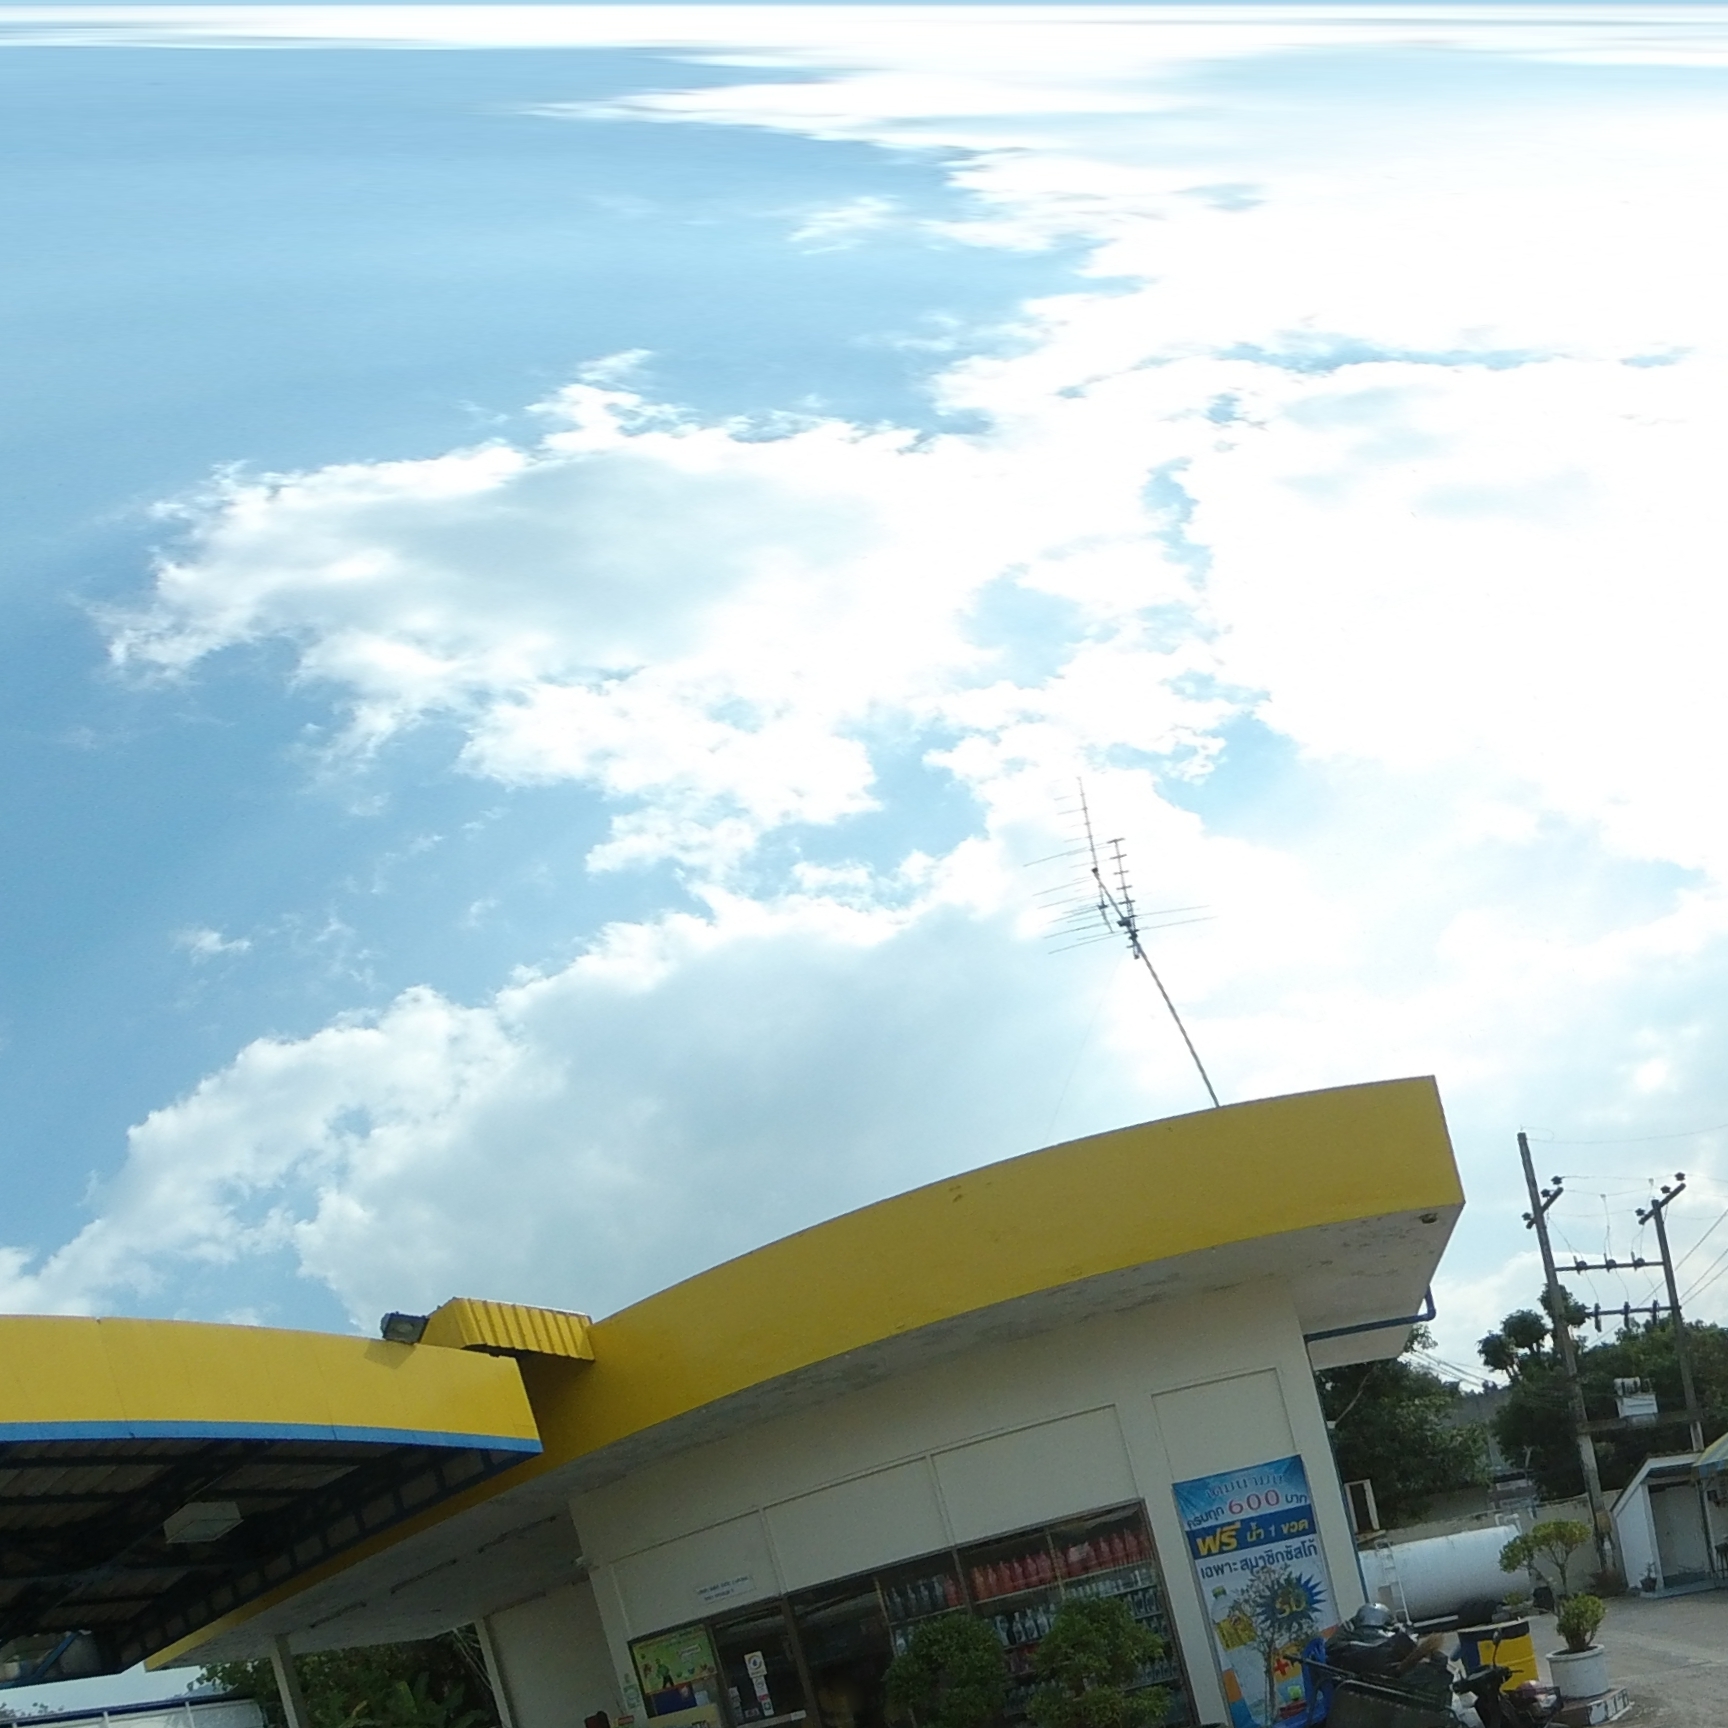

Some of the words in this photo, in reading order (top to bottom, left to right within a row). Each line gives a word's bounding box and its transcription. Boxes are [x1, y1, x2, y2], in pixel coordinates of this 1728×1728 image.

[1187, 1506, 1225, 1529] ครบทุก
[1228, 1489, 1280, 1515] 600
[1285, 1493, 1308, 1504] บาท
[1196, 1520, 1241, 1556] ฟรี
[1246, 1522, 1265, 1542] น้ำ
[1269, 1524, 1276, 1538] 1
[1281, 1518, 1309, 1534] ขวด
